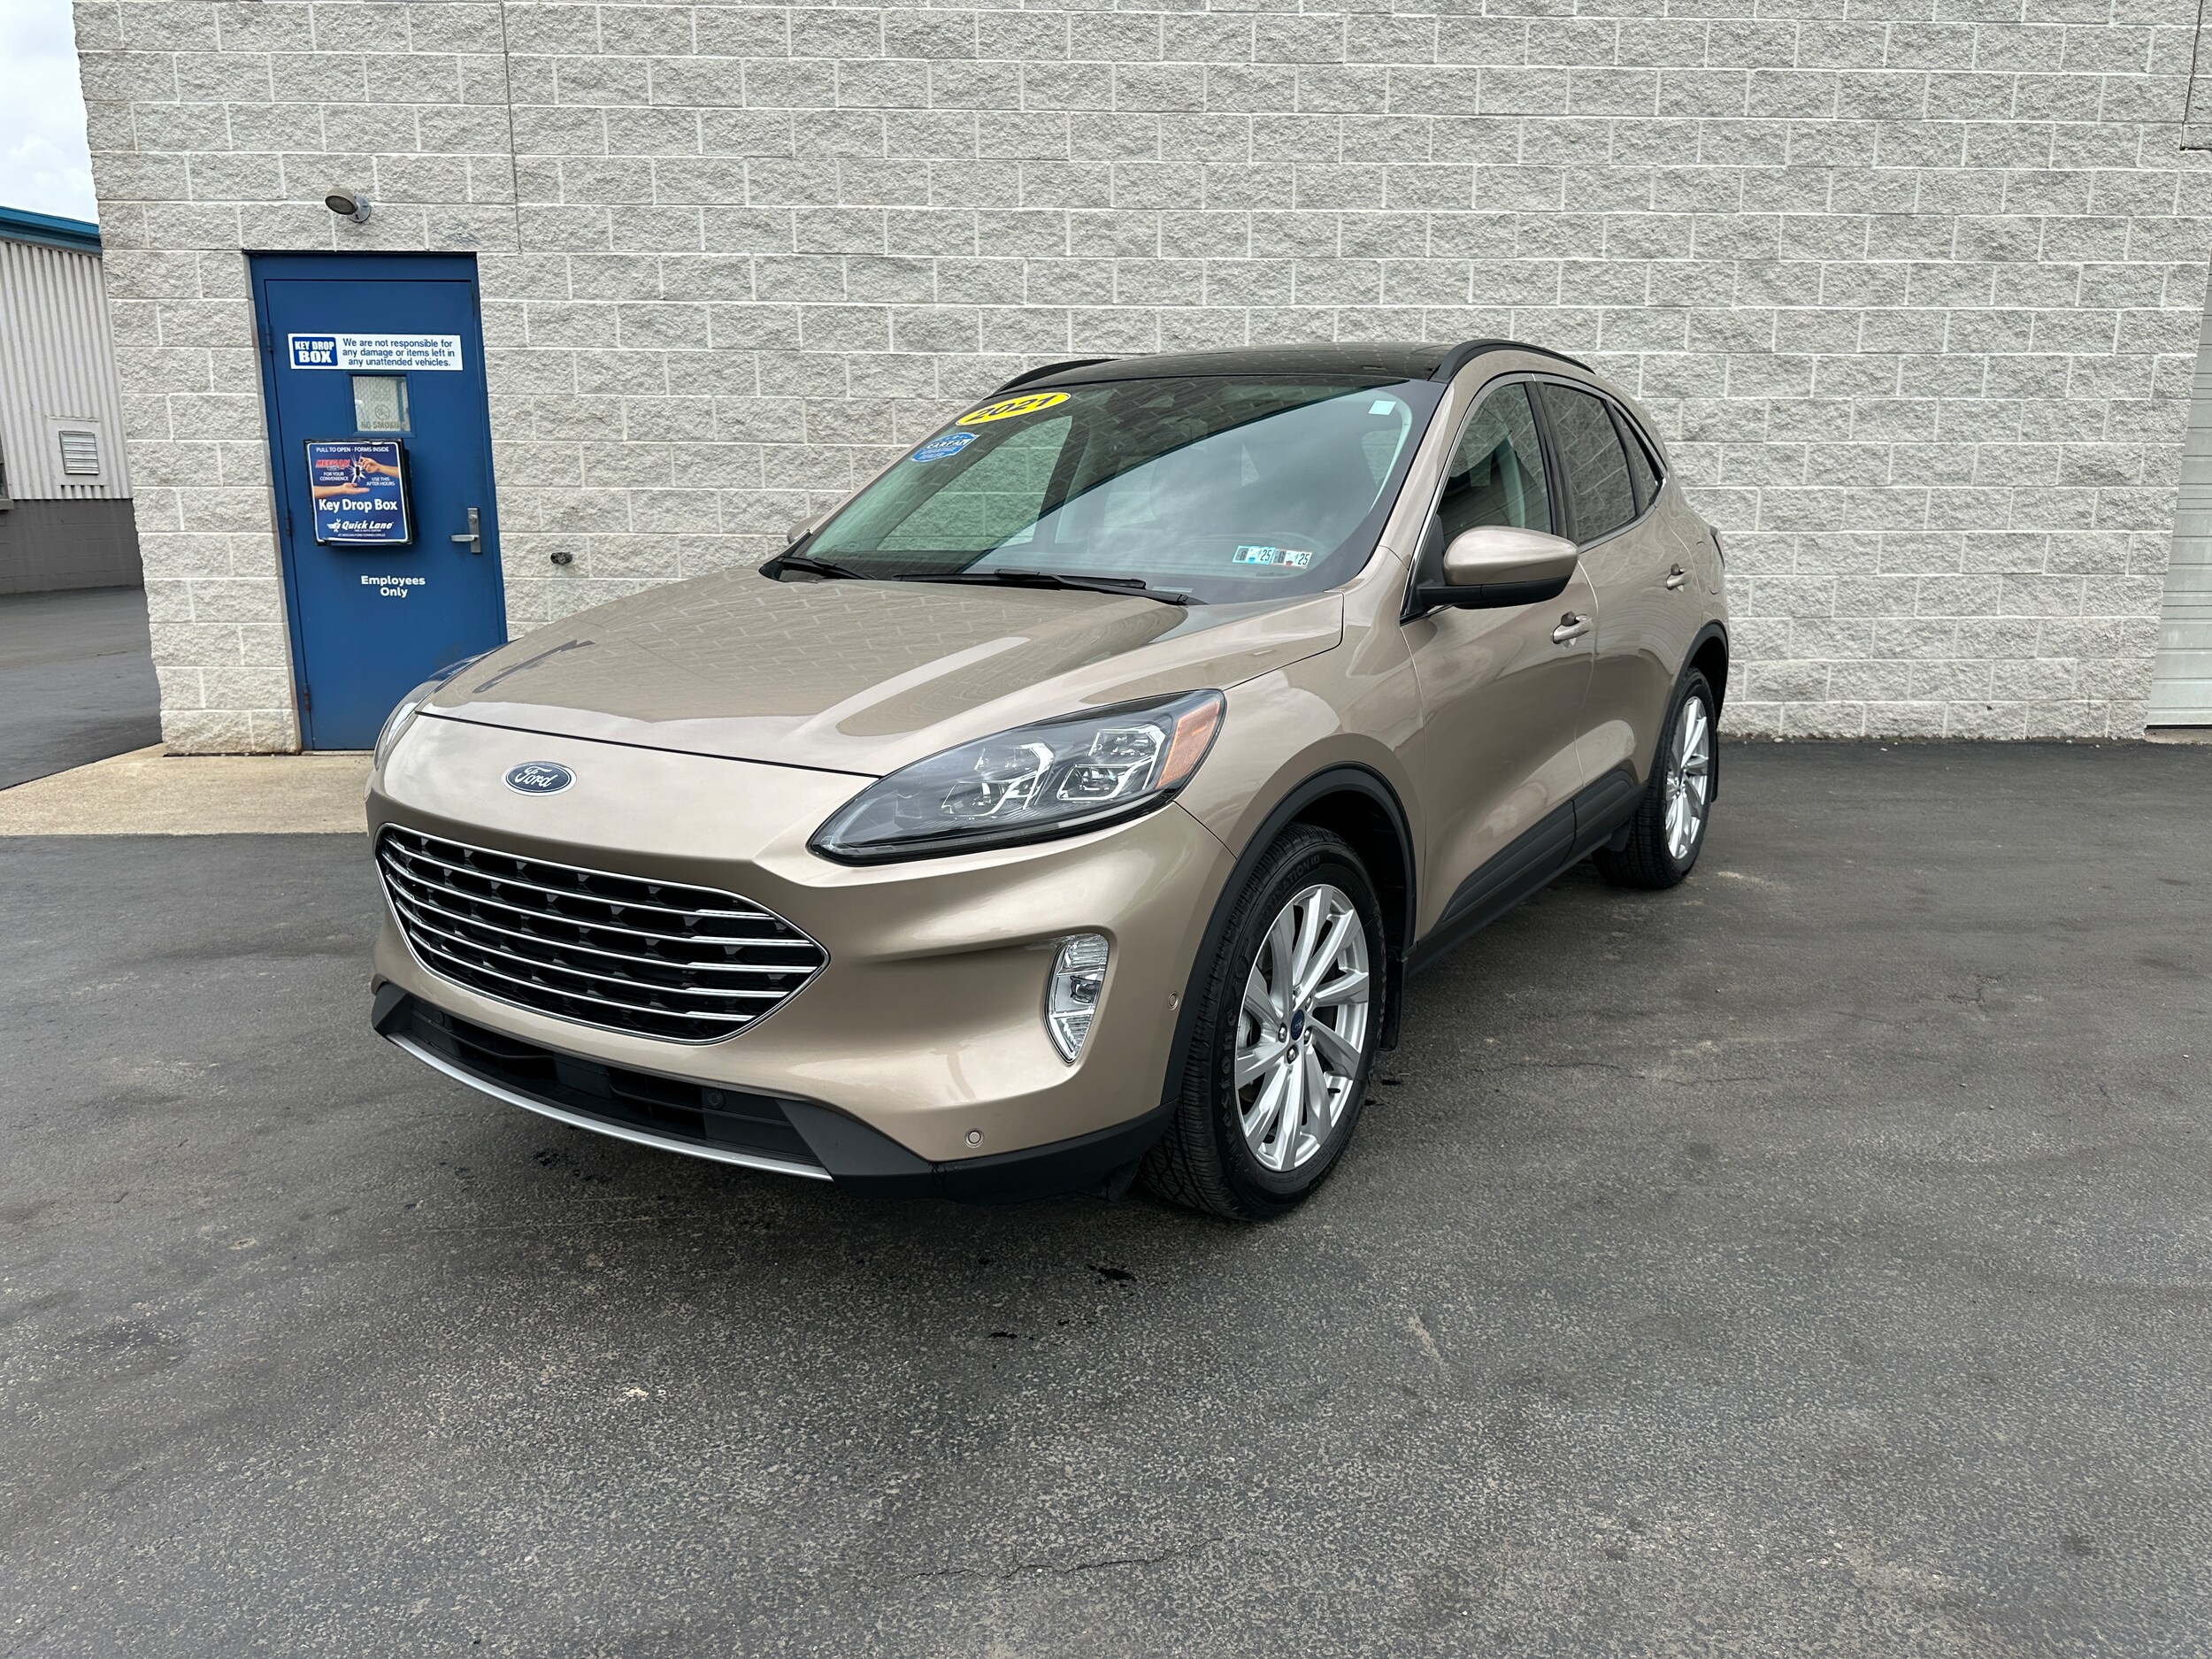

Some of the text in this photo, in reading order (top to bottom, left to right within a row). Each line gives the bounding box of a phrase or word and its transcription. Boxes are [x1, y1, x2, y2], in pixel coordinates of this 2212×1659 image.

[294, 341, 334, 350] KEY DROP
[342, 338, 357, 347] We
[390, 339, 438, 349] responsible
[441, 339, 453, 348] for
[298, 350, 332, 363] BOX
[342, 349, 357, 357] any
[360, 348, 393, 358] damage
[348, 357, 451, 367] any unattended vehicles.
[964, 395, 1058, 423] 2021
[319, 498, 398, 513] Key Drop Box
[342, 520, 368, 530] Quick
[361, 575, 426, 587] Employees
[380, 587, 408, 598] Only
[514, 765, 558, 787] Ford
